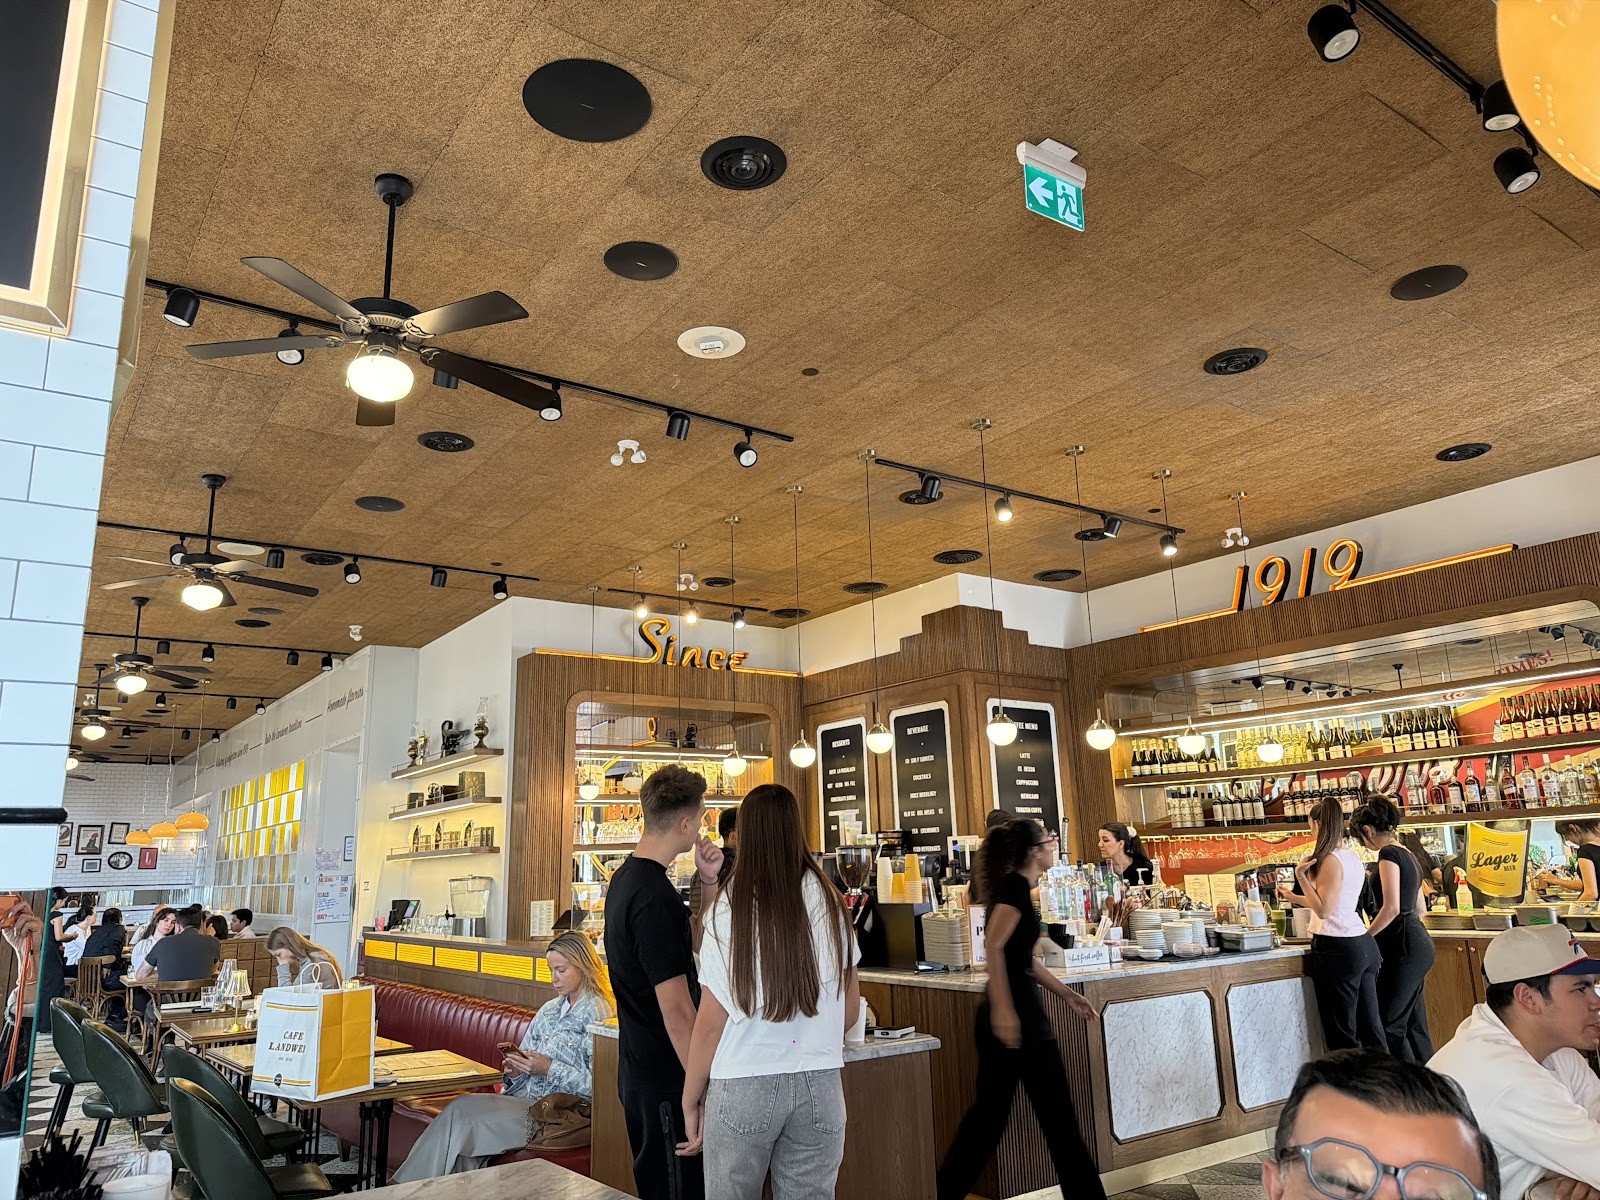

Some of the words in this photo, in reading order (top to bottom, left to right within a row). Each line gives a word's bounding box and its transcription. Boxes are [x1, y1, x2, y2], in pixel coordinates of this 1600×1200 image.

[1231, 538, 1364, 611] 1919
[638, 617, 750, 671] Since
[907, 725, 929, 735] BEVERAGE
[1025, 722, 1038, 731] MENU
[912, 773, 932, 781] COCKTAILS
[1470, 851, 1519, 870] Lager
[1080, 952, 1091, 964] first
[1091, 950, 1103, 960] coffee
[284, 1031, 304, 1040] CAFE
